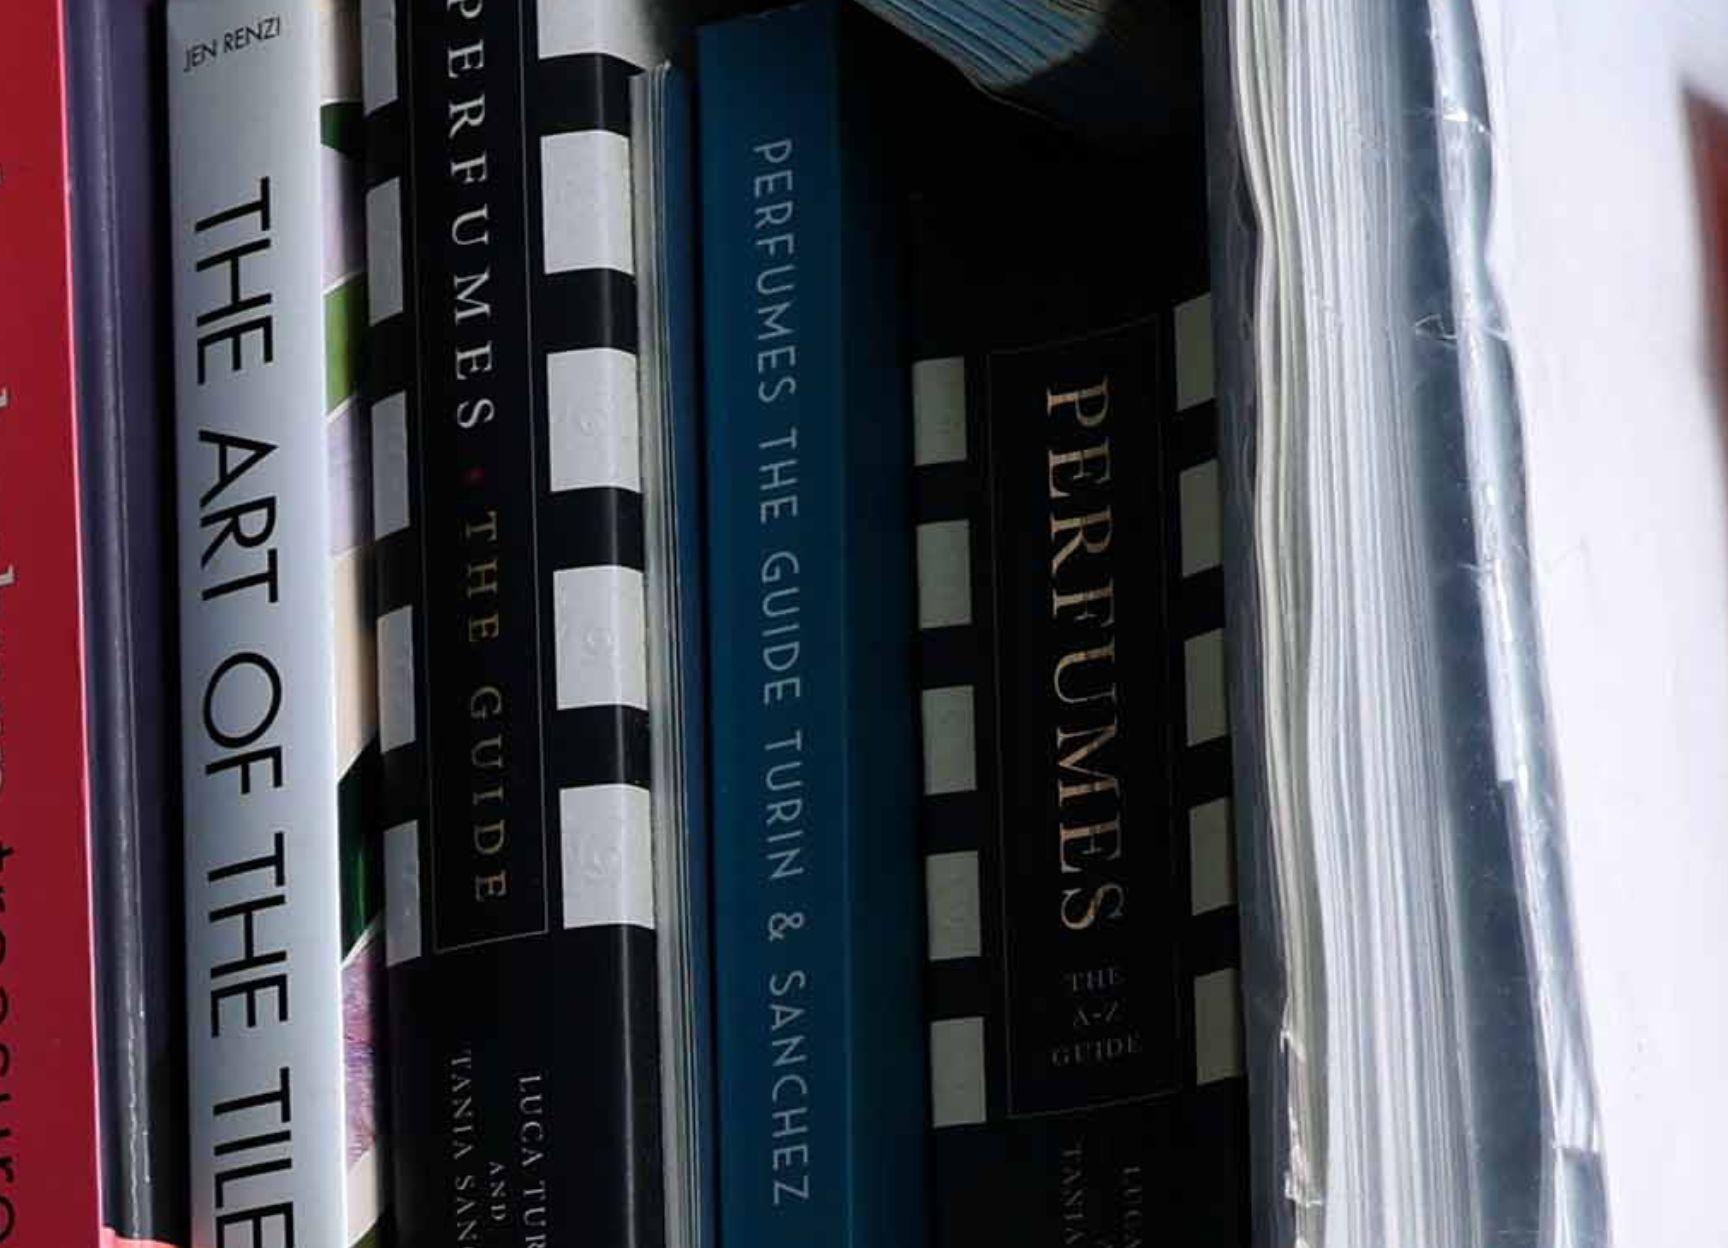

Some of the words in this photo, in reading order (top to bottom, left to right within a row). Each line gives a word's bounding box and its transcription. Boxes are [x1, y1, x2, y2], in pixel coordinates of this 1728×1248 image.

[183, 38, 220, 73] JEN
[222, 16, 281, 54] RENZI
[194, 175, 275, 386] THE
[752, 136, 798, 405] PERFUMES
[198, 428, 279, 603] ART
[758, 428, 799, 524] THE
[466, 510, 500, 643] THE
[761, 551, 802, 707] GUIDE
[1045, 374, 1127, 931] PERFUMES
[203, 650, 283, 795] OF
[469, 684, 508, 905] GUIDE
[765, 731, 805, 882] TURIN
[207, 832, 288, 1038] THE
[767, 911, 807, 943] &
[211, 1066, 295, 1248] TILE
[519, 1074, 544, 1167] LUCA
[769, 968, 810, 1206] SANCHEZ
[489, 1161, 507, 1221] AND
